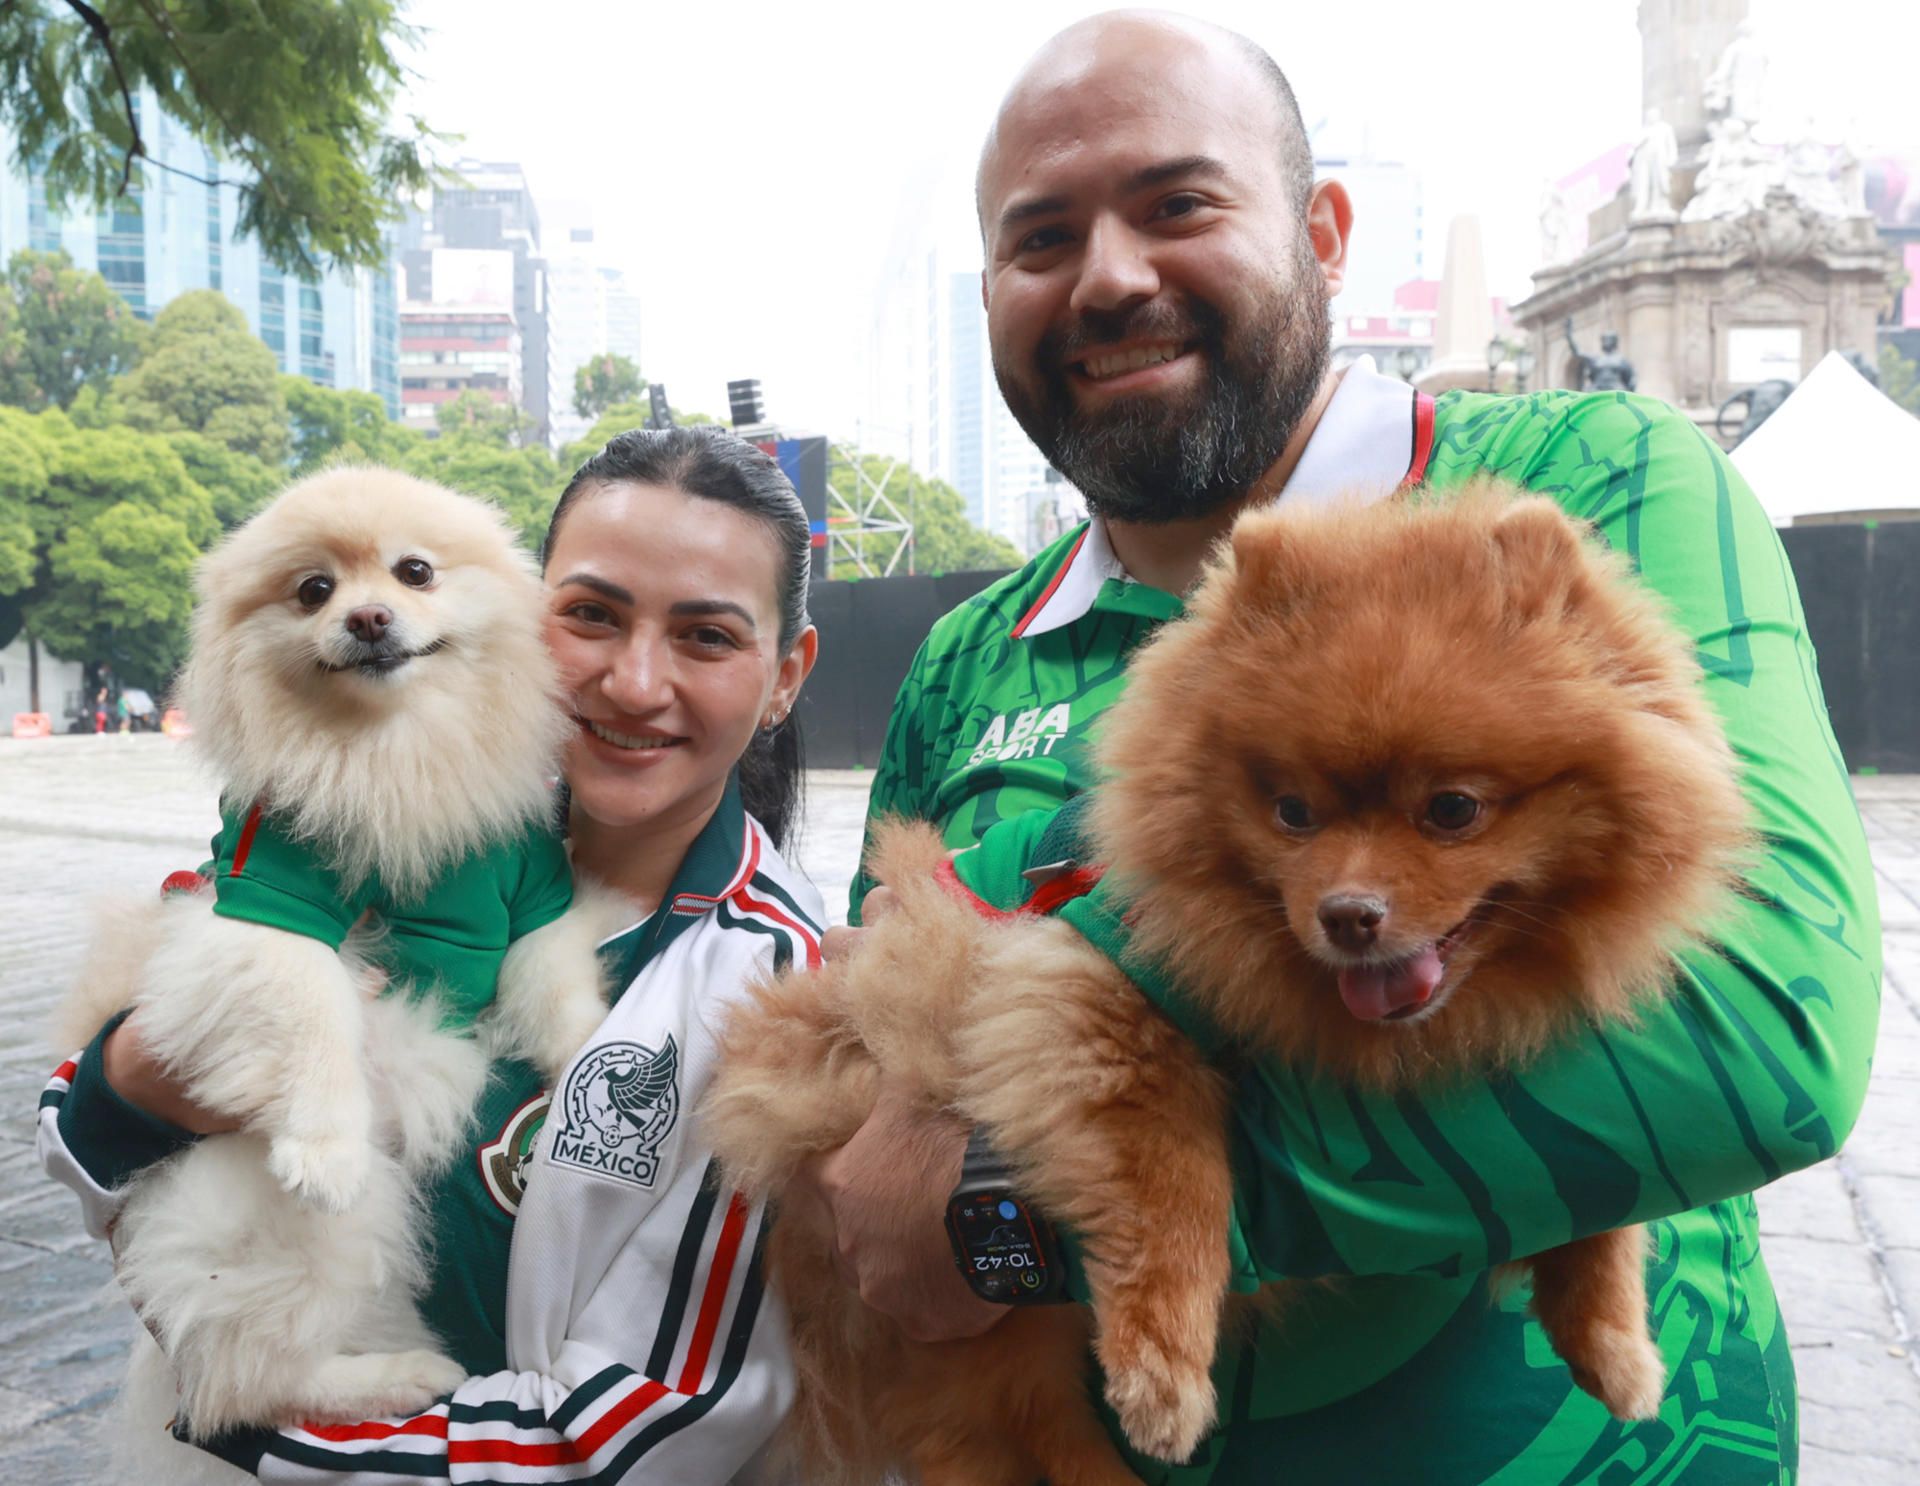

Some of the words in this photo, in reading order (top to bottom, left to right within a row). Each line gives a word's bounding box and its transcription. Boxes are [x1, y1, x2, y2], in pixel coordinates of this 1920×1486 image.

[974, 703, 1071, 751] ABA
[963, 734, 1066, 769] SPORT
[558, 1139, 651, 1180] MÉXICO
[973, 1252, 1035, 1271] 10:42
